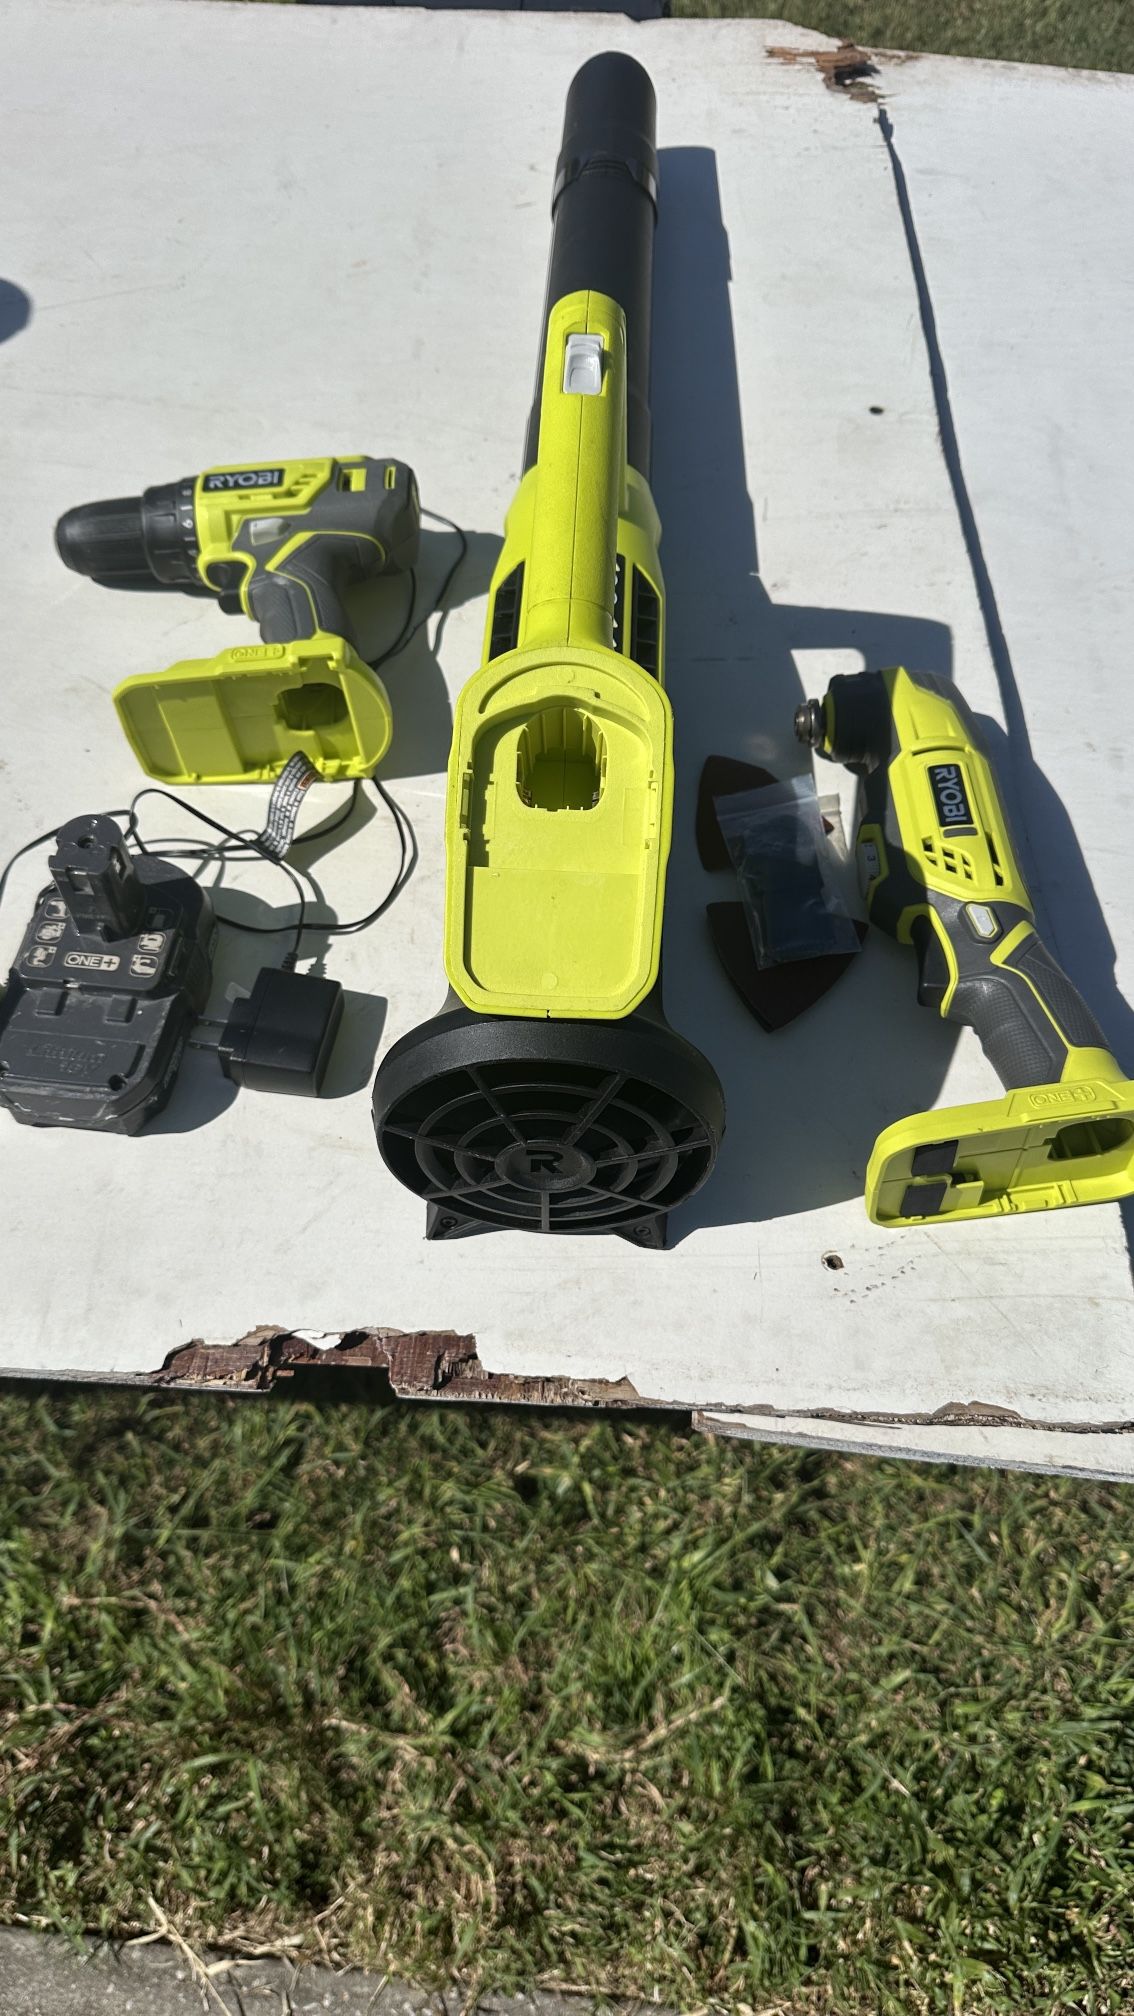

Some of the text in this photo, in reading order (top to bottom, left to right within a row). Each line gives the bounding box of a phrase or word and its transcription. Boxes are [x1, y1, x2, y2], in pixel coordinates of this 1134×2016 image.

[209, 470, 279, 489] RYOBI
[934, 766, 967, 822] RYOBI
[525, 1150, 564, 1174] R
